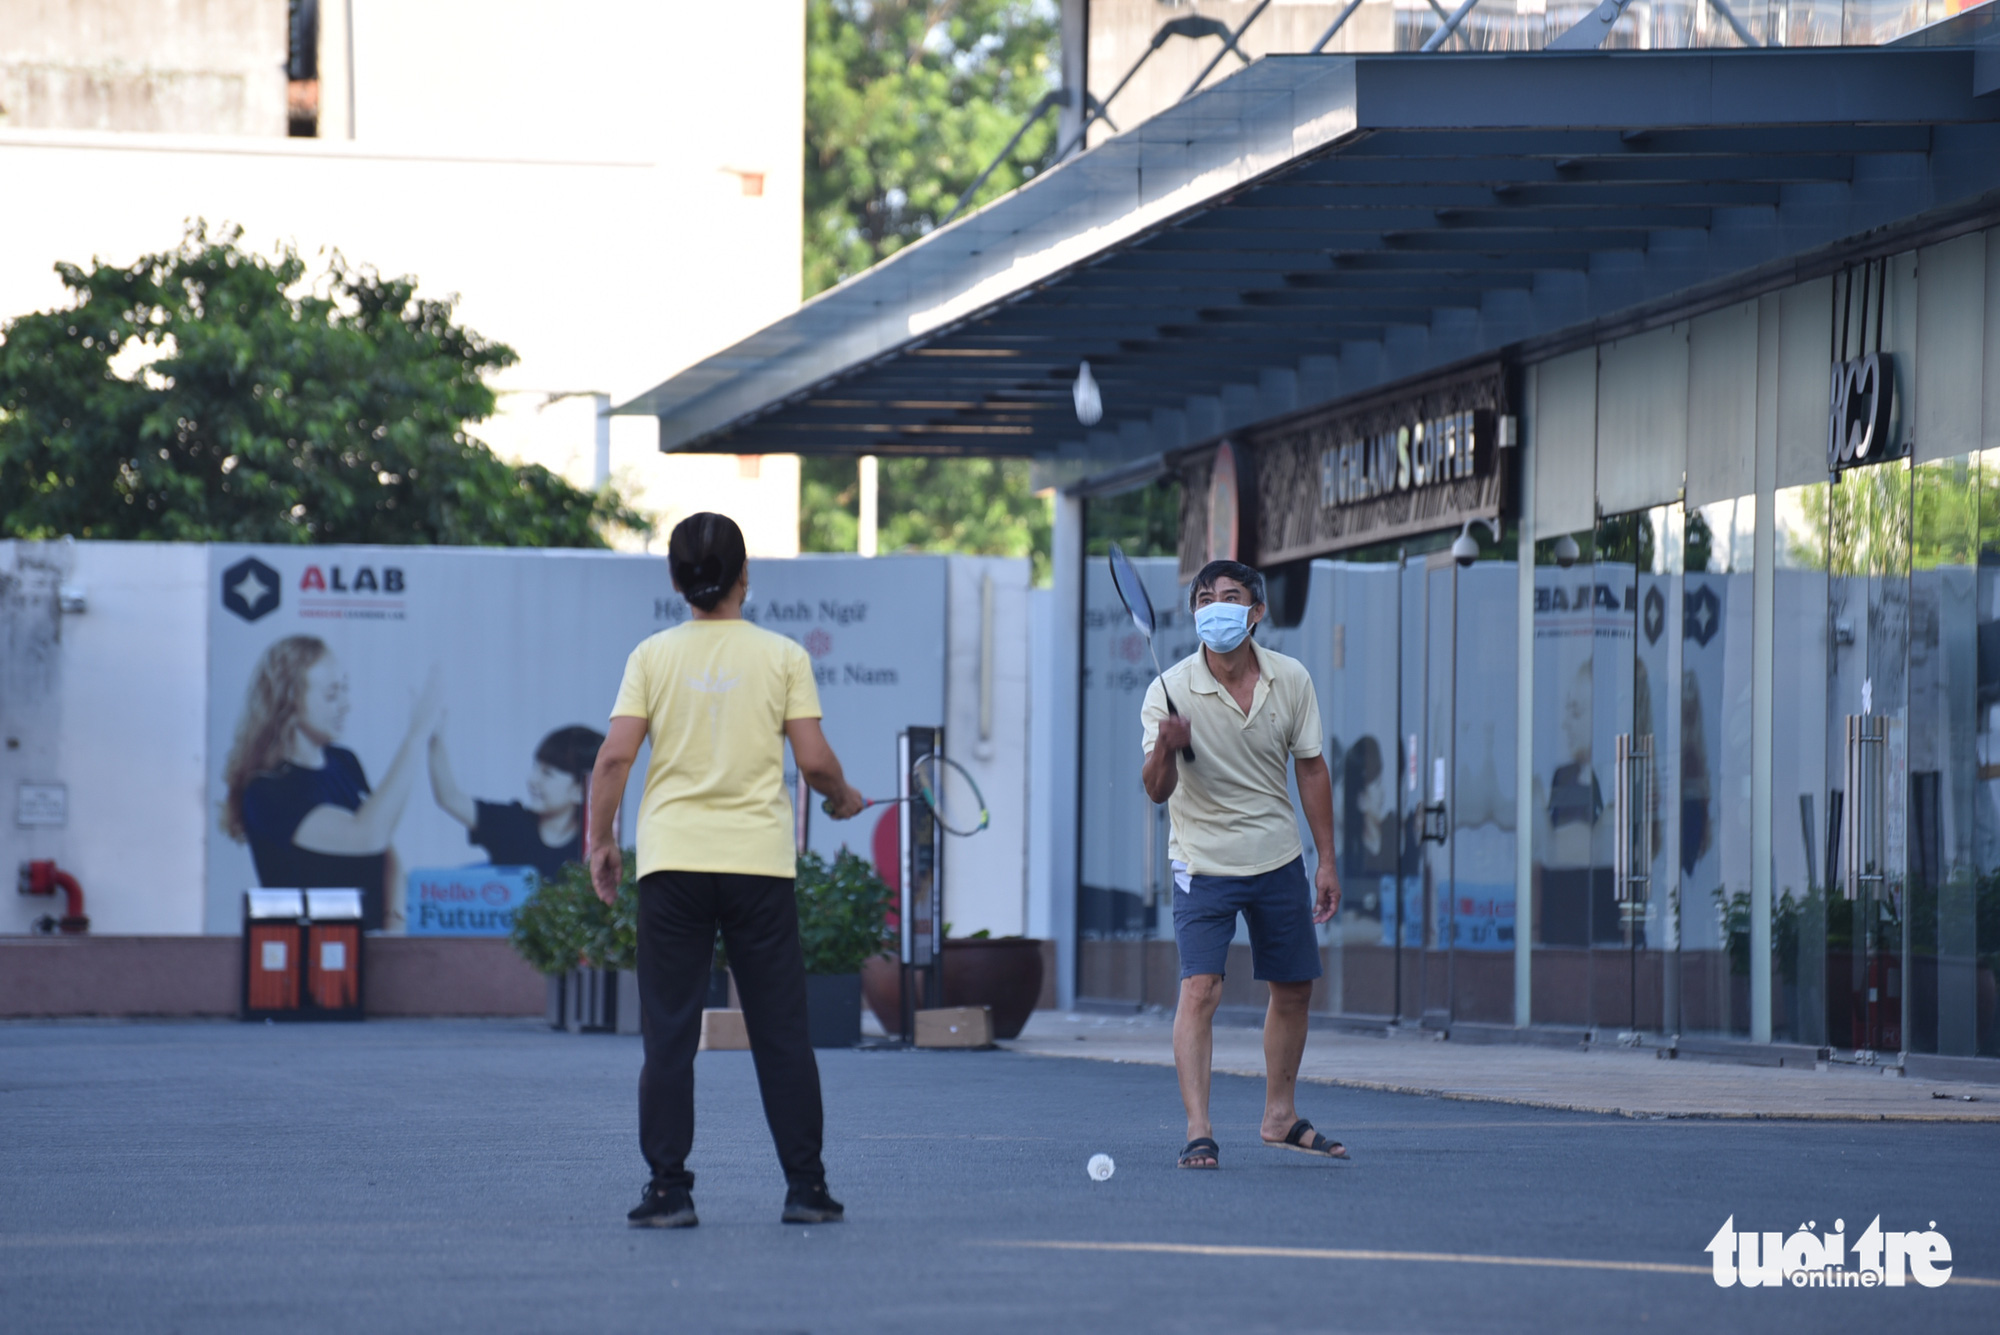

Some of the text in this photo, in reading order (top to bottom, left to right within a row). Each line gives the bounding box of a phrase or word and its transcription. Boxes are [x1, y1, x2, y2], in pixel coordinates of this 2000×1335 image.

[1413, 410, 1475, 486] COFFEE
[299, 563, 406, 593] ALAB
[764, 600, 812, 623] Anh
[843, 662, 898, 685] Nam
[420, 882, 476, 903] Hello
